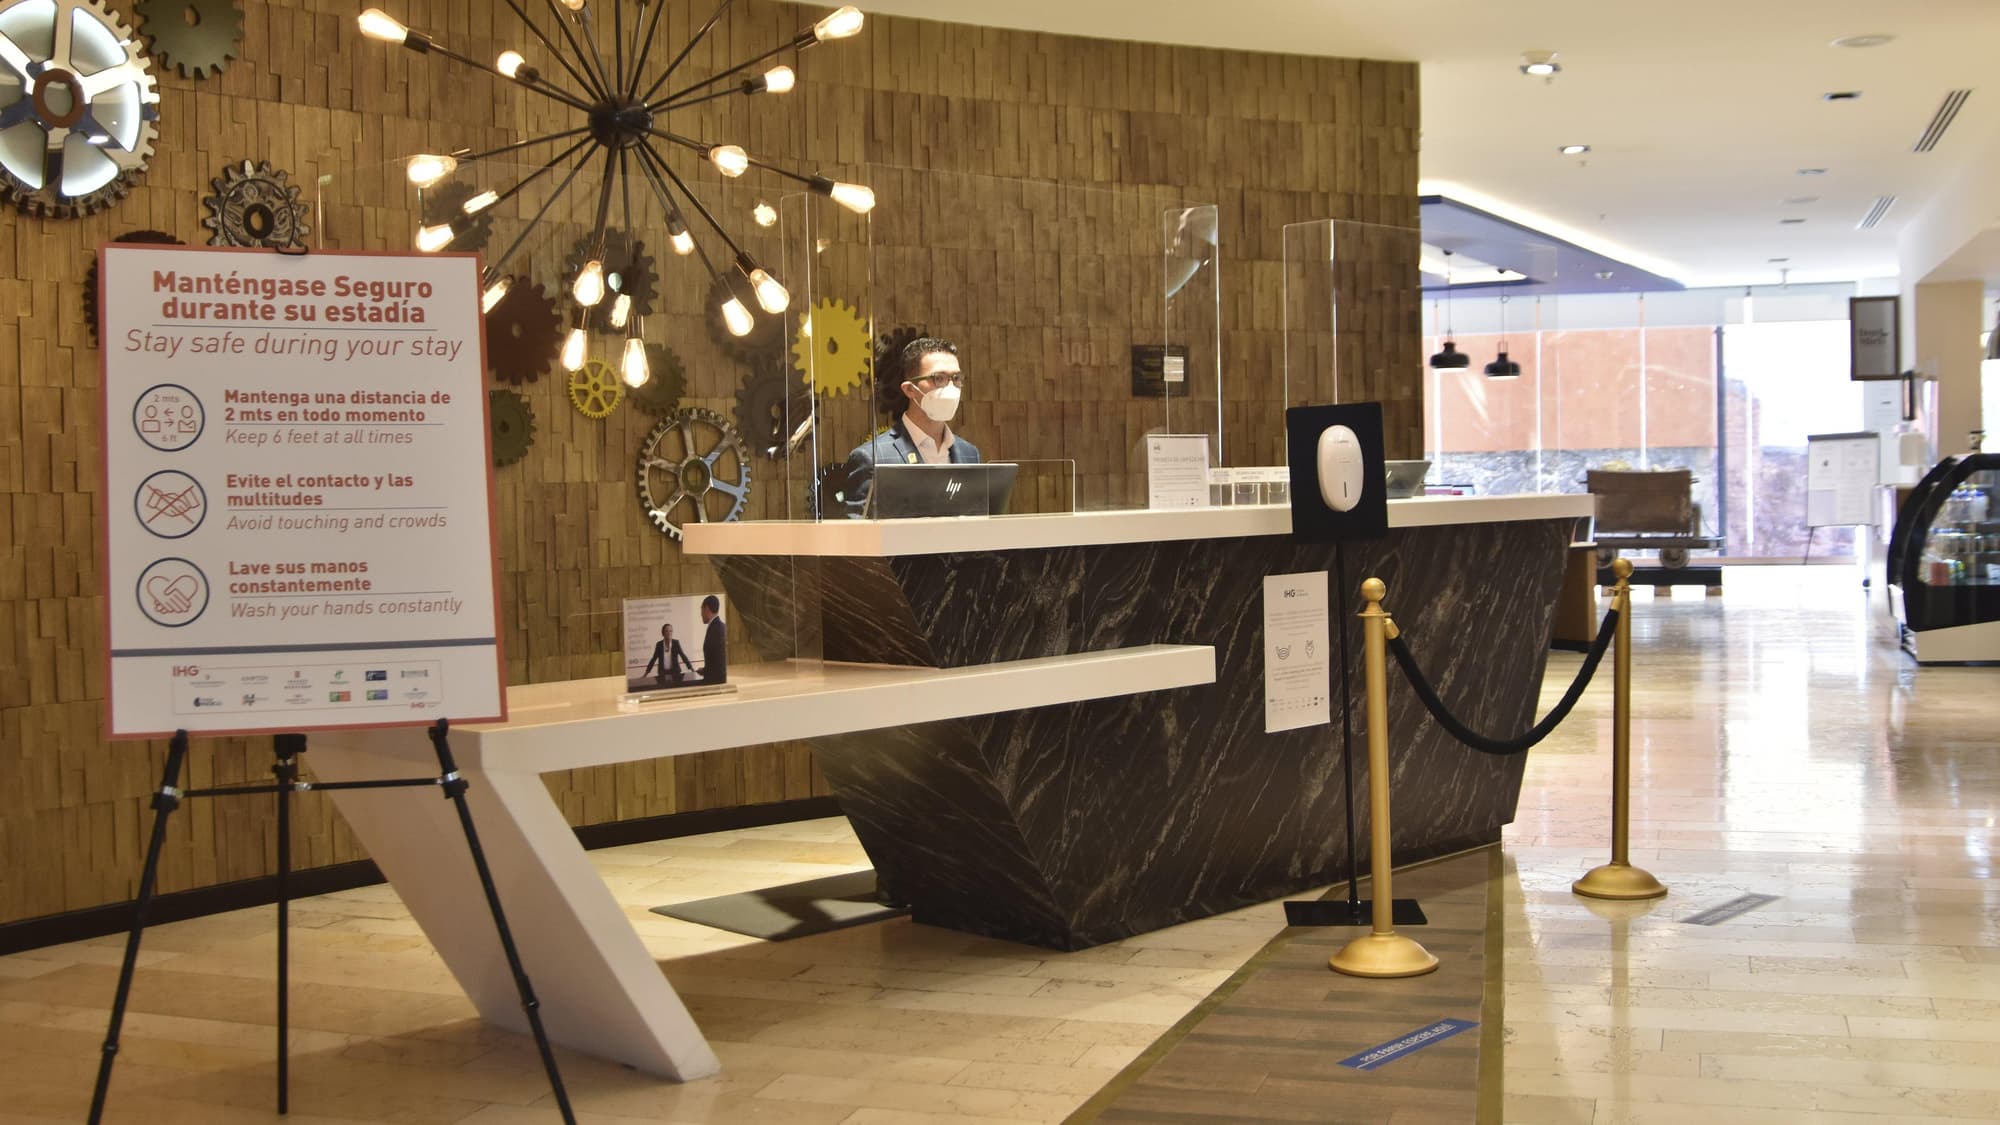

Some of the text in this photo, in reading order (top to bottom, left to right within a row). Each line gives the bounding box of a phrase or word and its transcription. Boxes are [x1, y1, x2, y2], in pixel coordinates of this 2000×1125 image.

[153, 270, 433, 303] Manténgase Seguro
[162, 298, 425, 323] durante su estadía
[125, 329, 462, 362] Stay safe during your stay
[224, 390, 451, 406] Mantenga una distancia de
[225, 409, 425, 422] 2 mts en todo momento
[226, 429, 413, 446] Keep 6 feet at all times
[226, 473, 414, 490] Evite el contacto y las
[946, 478, 961, 500] hp
[227, 492, 323, 506] multitudes
[227, 513, 447, 533] Avoid touching and crowds
[229, 561, 368, 575] Lave sus manos
[229, 578, 371, 593] constantemente
[230, 597, 463, 620] Wash your hands constantly
[172, 666, 200, 676] IHG
